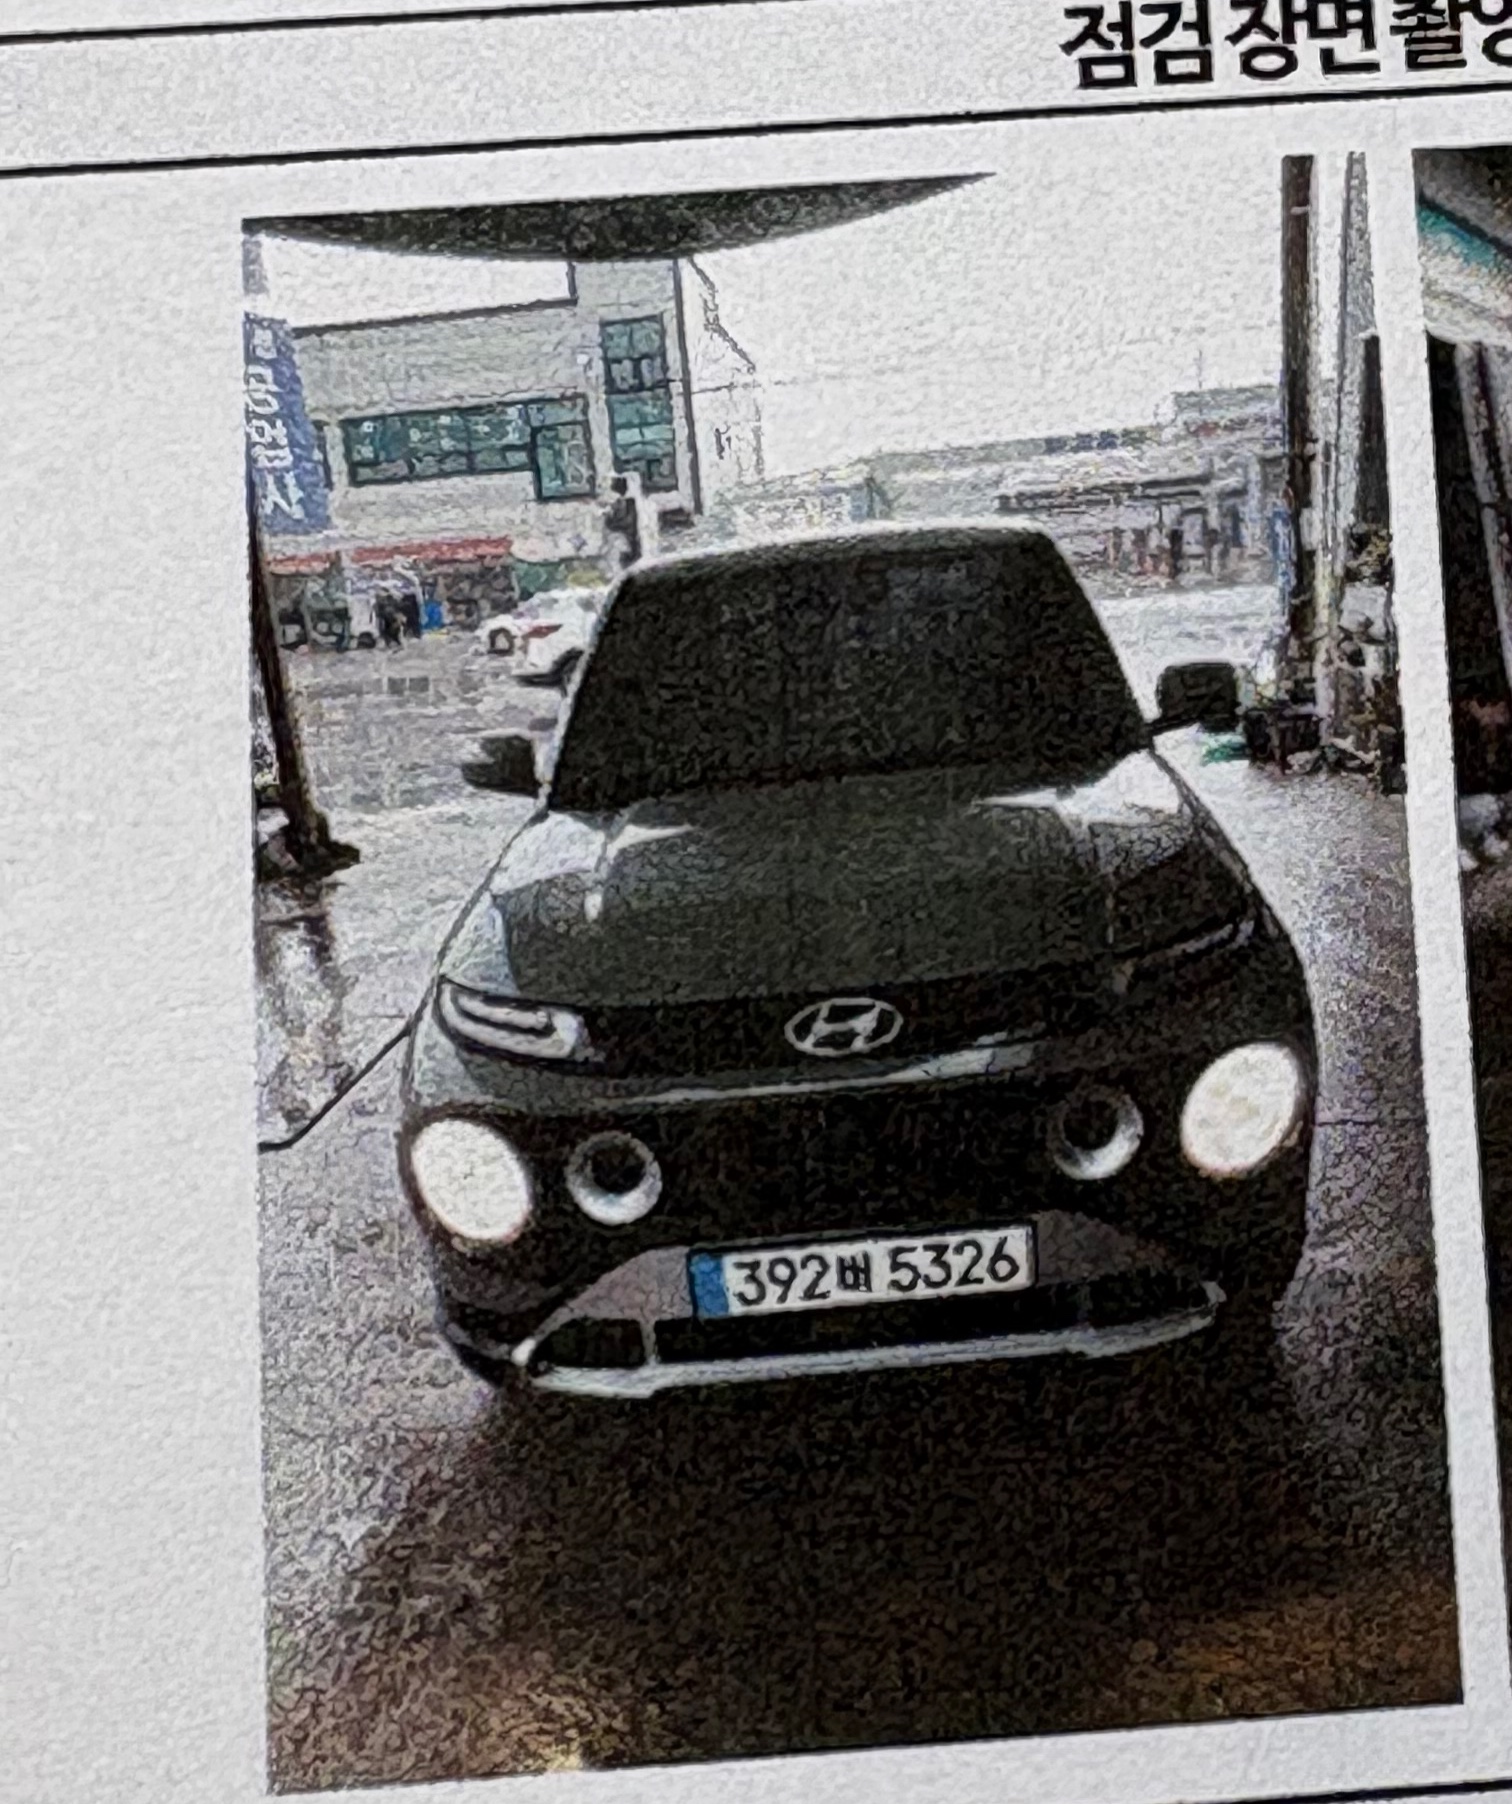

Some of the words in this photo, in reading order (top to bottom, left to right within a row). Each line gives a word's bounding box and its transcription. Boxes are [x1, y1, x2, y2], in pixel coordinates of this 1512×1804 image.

[1058, 0, 1215, 90] 점검
[1223, 0, 1381, 81] 장면
[732, 1250, 873, 1307] 392버
[886, 1235, 1021, 1294] 5326
